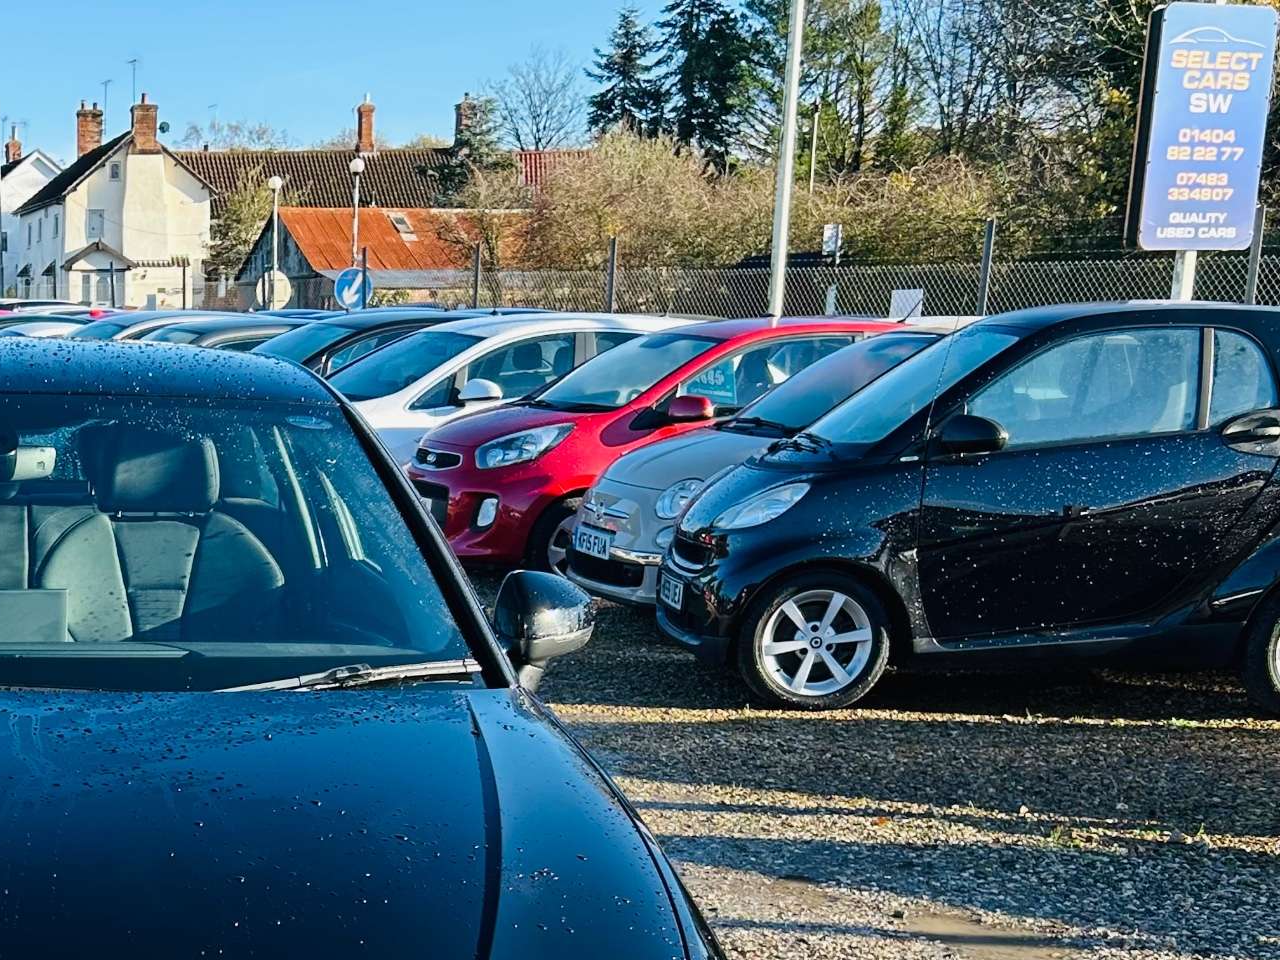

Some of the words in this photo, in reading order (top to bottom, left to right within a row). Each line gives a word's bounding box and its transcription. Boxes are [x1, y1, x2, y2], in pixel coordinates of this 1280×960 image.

[1171, 50, 1263, 71] SELECT
[1182, 71, 1250, 91] CARS
[1189, 93, 1233, 114] SW
[1178, 128, 1236, 143] 01404
[1176, 172, 1228, 186] 07483
[1169, 212, 1228, 224] QUALITY
[1156, 226, 1195, 238] USED
[1198, 227, 1236, 238] CARS
